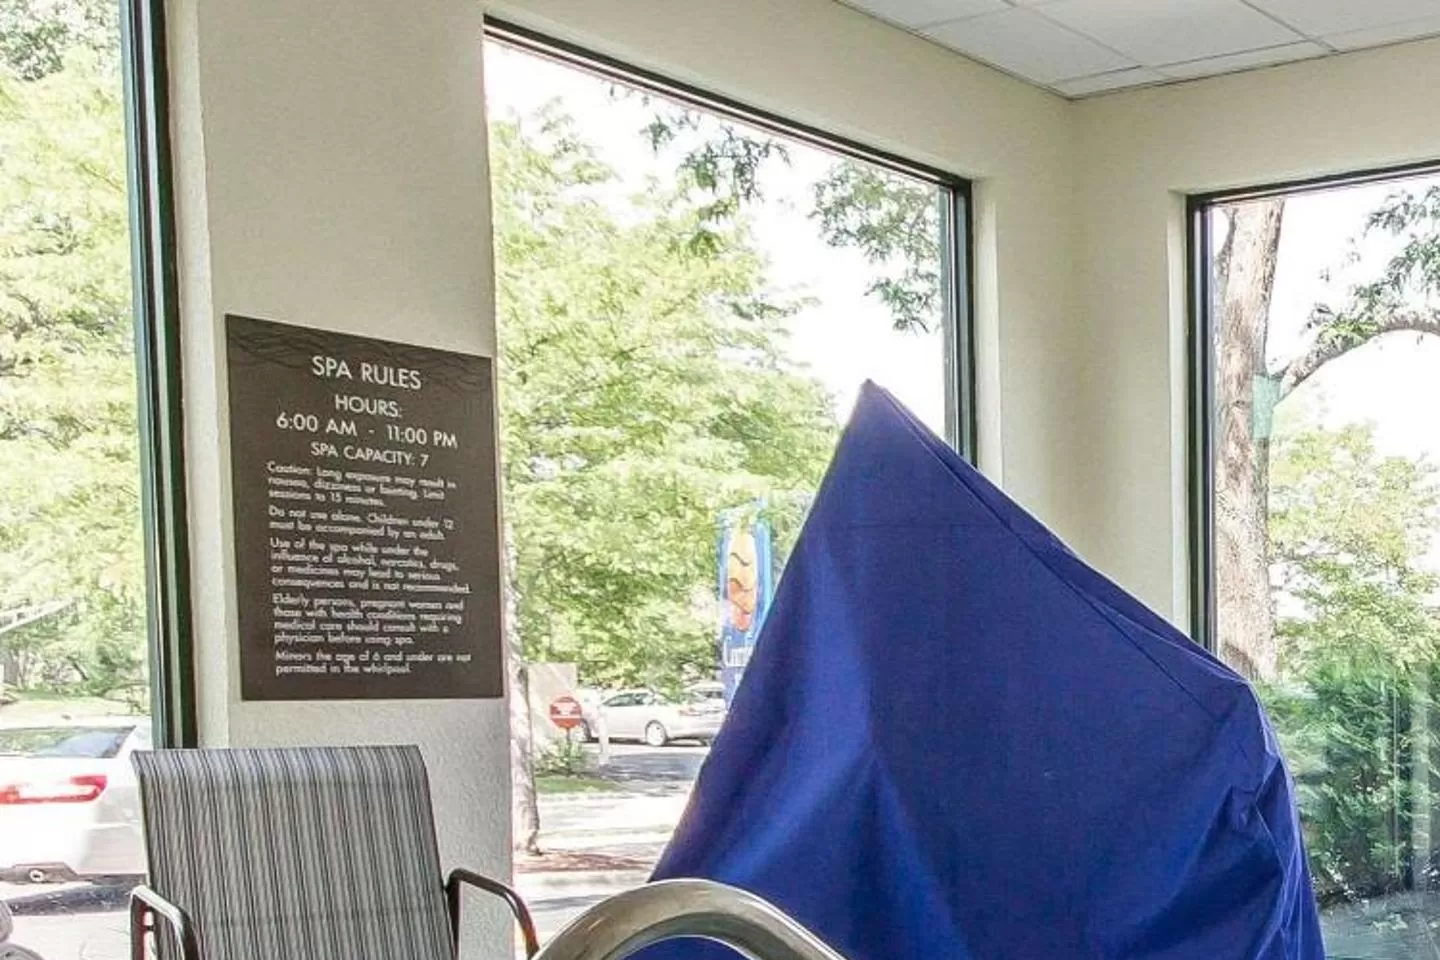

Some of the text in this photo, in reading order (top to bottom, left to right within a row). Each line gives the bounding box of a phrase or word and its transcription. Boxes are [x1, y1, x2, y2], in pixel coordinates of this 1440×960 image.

[312, 355, 422, 389] SPA RULES
[334, 394, 402, 418] HOURS:
[275, 412, 318, 432] 6:00
[325, 418, 357, 436] AM
[386, 424, 428, 445] 11:00
[433, 430, 459, 448] PM
[310, 441, 429, 466] SPA CAPACITY: 7
[316, 466, 343, 481] Long
[394, 476, 416, 487] may
[330, 491, 342, 502] 15
[269, 505, 285, 516] Do
[368, 512, 410, 525] Children
[412, 516, 439, 527] under
[297, 519, 312, 531] be
[387, 526, 400, 539] by
[270, 537, 429, 556] Use of the spa while under the
[322, 552, 333, 563] of
[343, 569, 366, 578] may
[394, 570, 404, 578] to
[348, 579, 369, 589] and
[273, 606, 302, 617] those
[305, 607, 328, 617] with
[331, 606, 363, 618] health
[445, 600, 464, 610] and
[274, 619, 316, 630] medical
[346, 620, 379, 631] should
[327, 631, 362, 643] before
[275, 650, 312, 660] Minors
[316, 650, 332, 660] the
[335, 654, 356, 666] age
[358, 650, 369, 661] of
[383, 651, 403, 661] and
